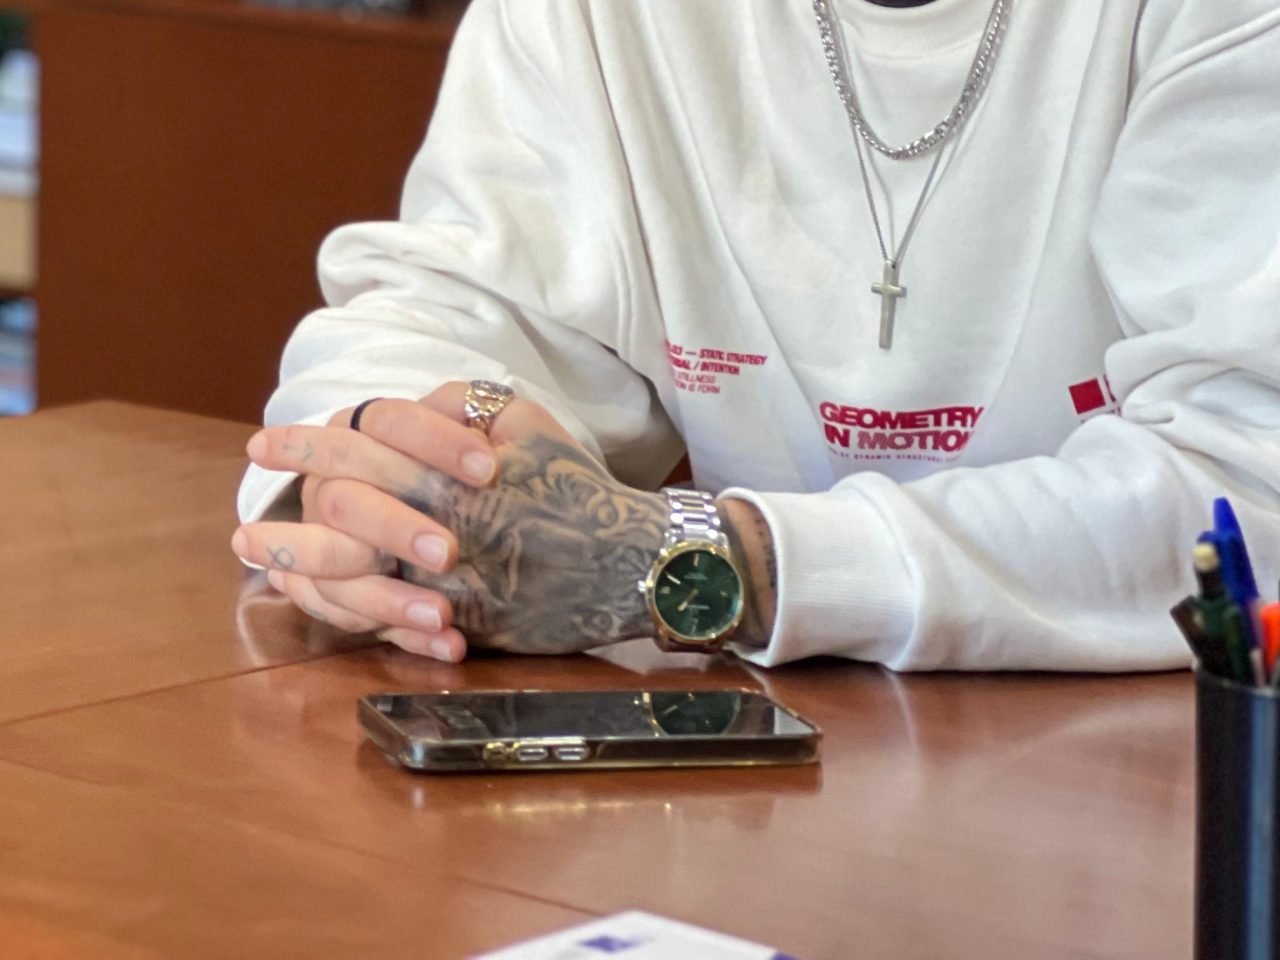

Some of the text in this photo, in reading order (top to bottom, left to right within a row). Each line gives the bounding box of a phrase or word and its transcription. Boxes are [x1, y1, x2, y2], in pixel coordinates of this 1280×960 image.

[726, 352, 768, 366] STRATEGY
[700, 361, 739, 375] INTENTION
[698, 384, 720, 394] FORM
[820, 401, 984, 429] GEOMETRY
[824, 423, 850, 448] IN
